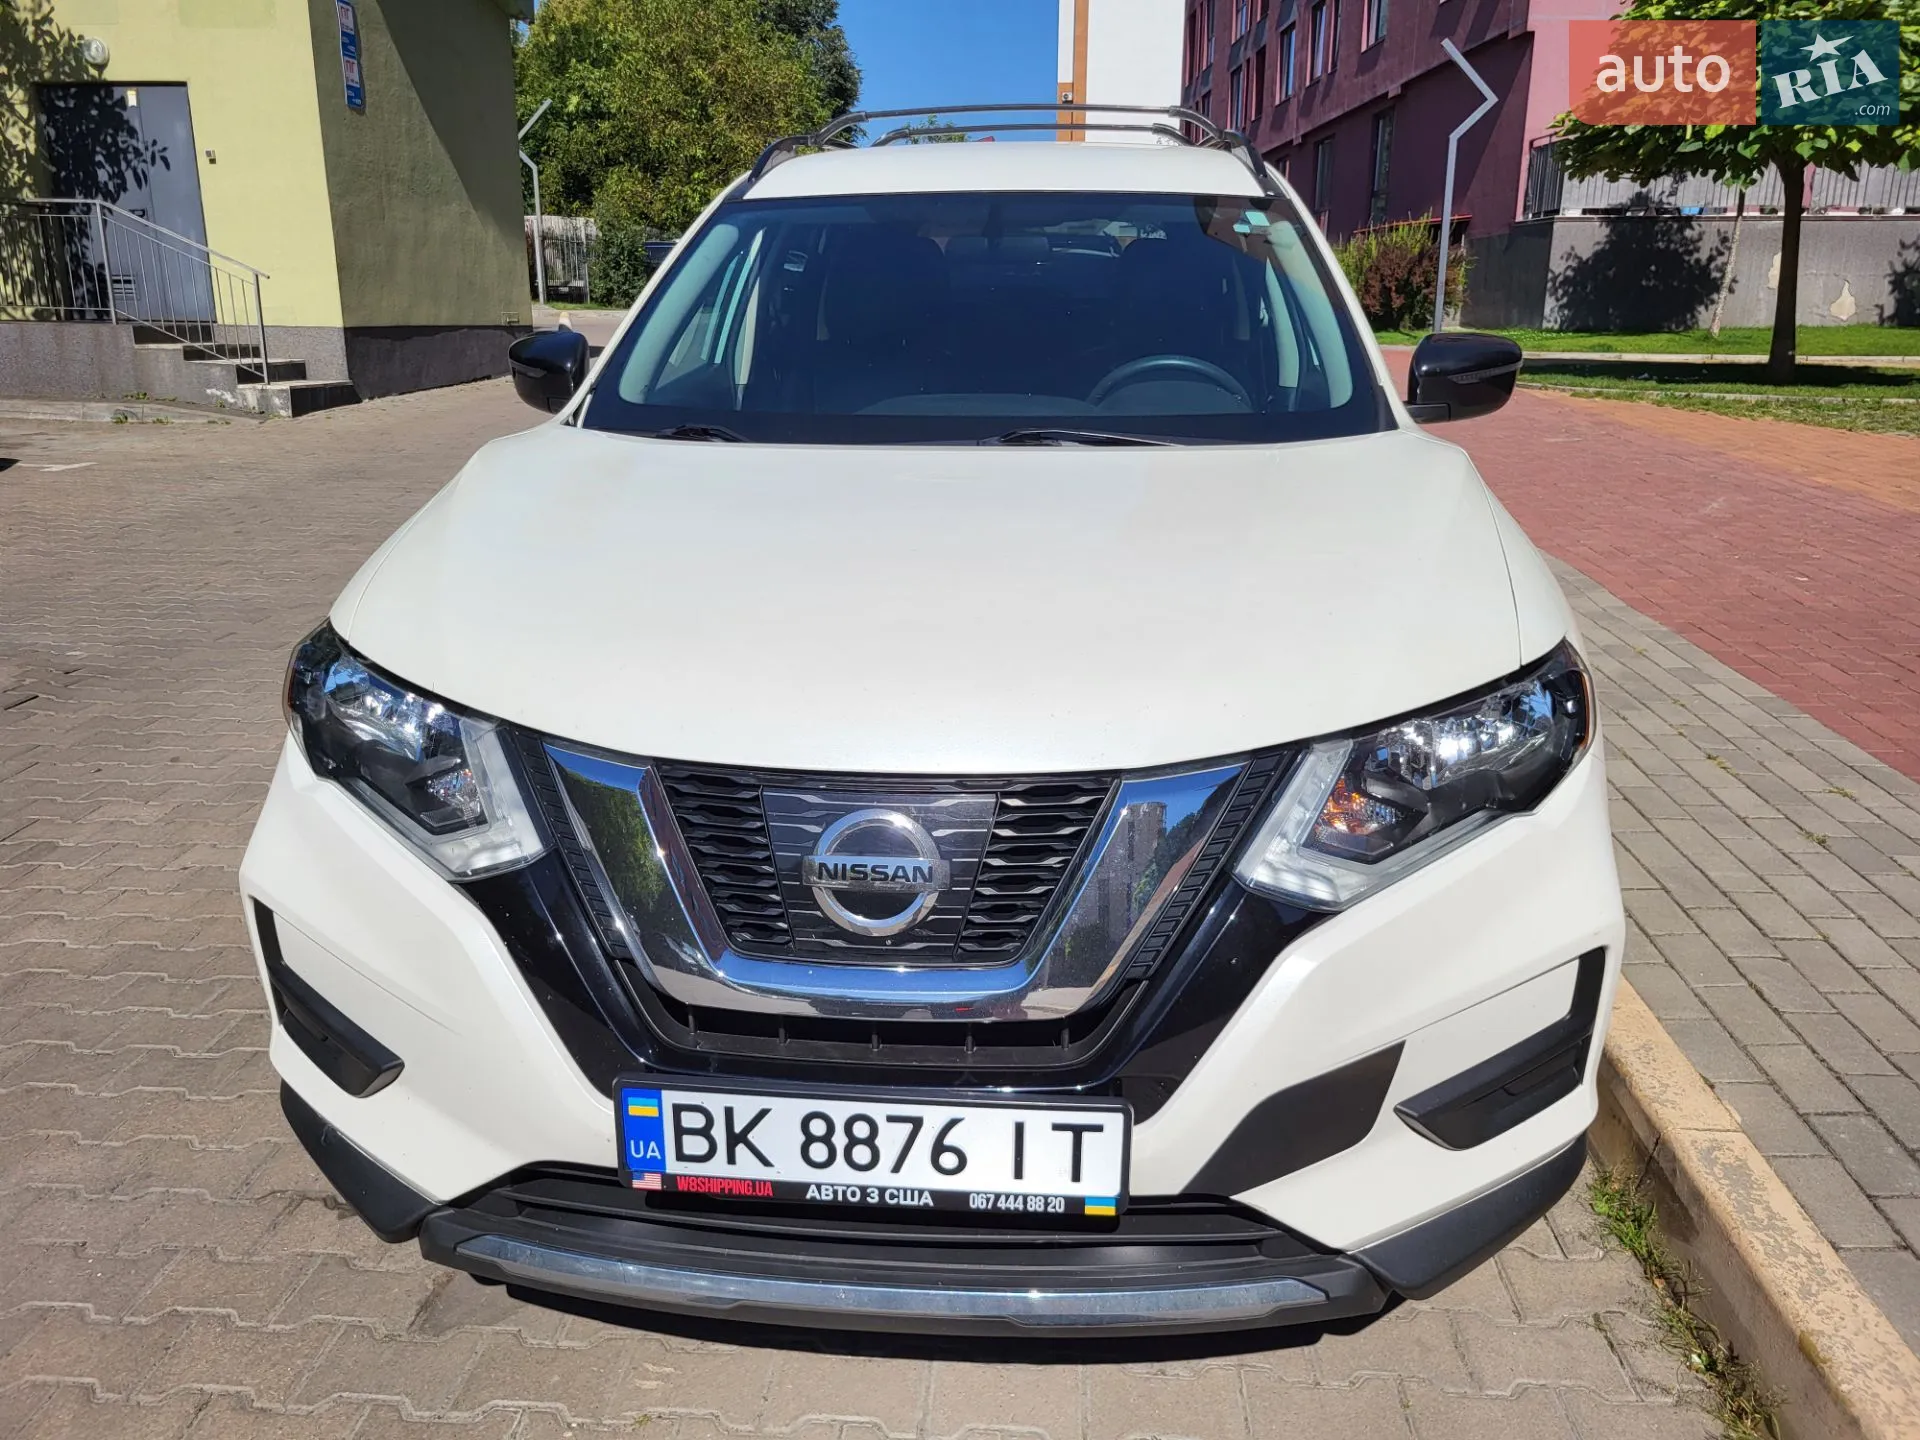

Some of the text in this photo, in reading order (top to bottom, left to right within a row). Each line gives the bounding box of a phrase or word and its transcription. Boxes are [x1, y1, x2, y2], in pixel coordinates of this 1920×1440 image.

[817, 862, 933, 883] NISSAN
[630, 1141, 662, 1160] UA
[671, 1102, 1104, 1183] BK 8876 IT
[676, 1176, 773, 1197] W8SHIPPING.UA
[805, 1184, 861, 1203] АВТО
[884, 1188, 935, 1207] США
[969, 1192, 1066, 1213] 067 444 88 20
